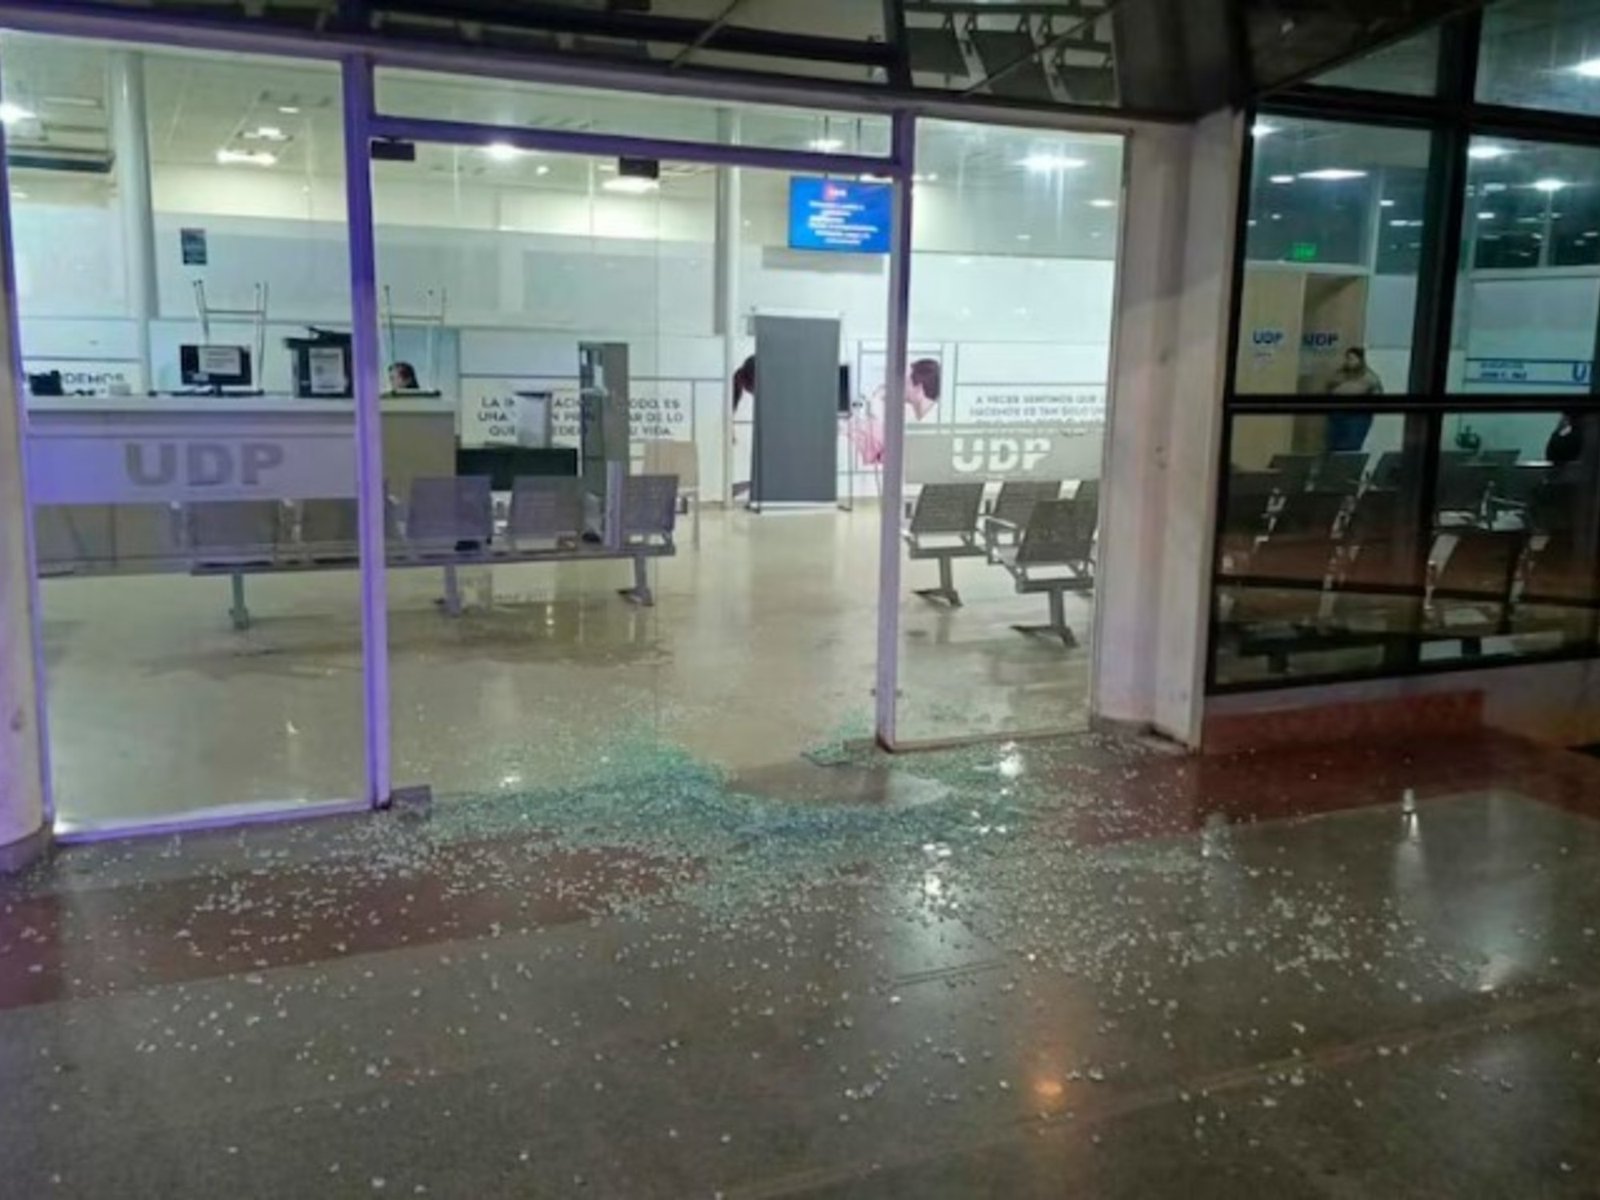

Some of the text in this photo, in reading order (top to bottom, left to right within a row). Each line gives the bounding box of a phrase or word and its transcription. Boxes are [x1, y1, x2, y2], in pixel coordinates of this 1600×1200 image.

[1253, 329, 1283, 344] UDP
[125, 442, 285, 488] UDP
[952, 437, 1051, 472] UDP
